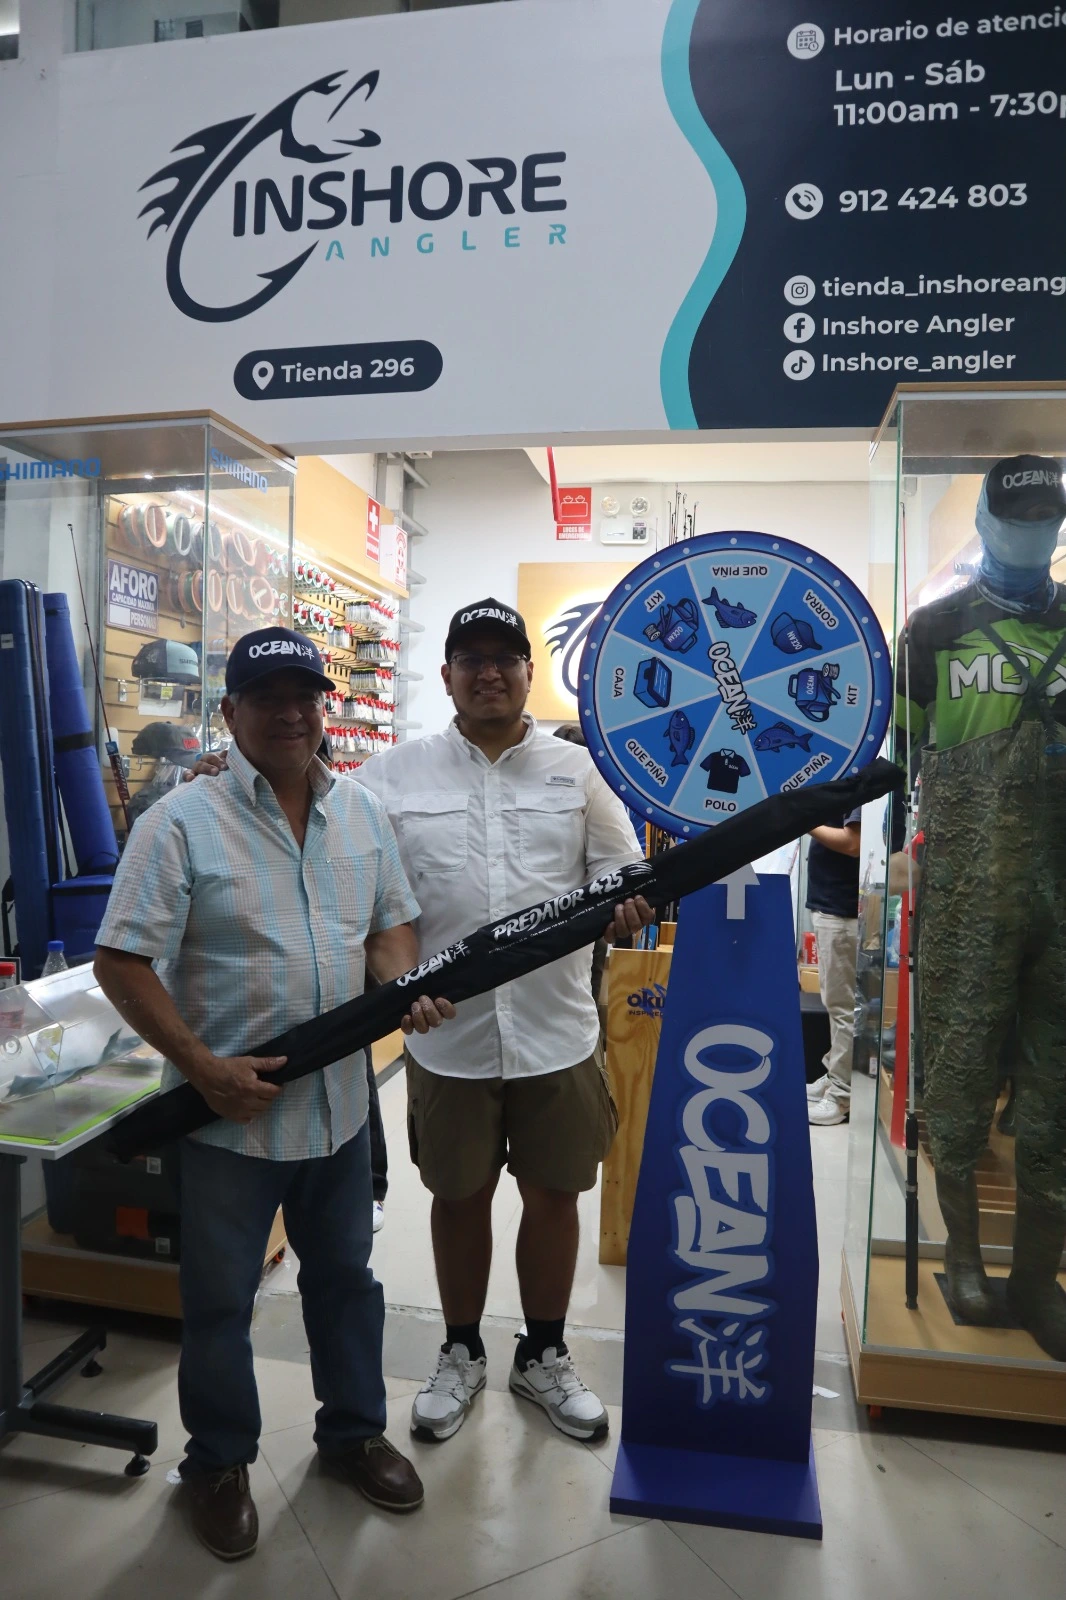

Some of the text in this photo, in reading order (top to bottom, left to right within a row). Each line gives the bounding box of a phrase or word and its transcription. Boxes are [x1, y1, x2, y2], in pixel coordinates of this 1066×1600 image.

[835, 22, 928, 45] Horario
[936, 18, 968, 37] de
[836, 70, 893, 91] Lun
[925, 60, 985, 85] Sáb
[834, 101, 957, 125] 11:00am
[232, 151, 567, 237] INSHORE
[840, 183, 1027, 212] 912 424 803
[325, 223, 567, 262] ANGLER
[822, 274, 1066, 297] tienda_inshoreang
[824, 314, 1015, 337] Inshore Angler
[281, 358, 414, 382] Tienda 296
[823, 351, 1015, 374] Inshore_angler
[211, 448, 268, 493] SHIMANO
[110, 564, 157, 601] AFORO
[711, 566, 768, 578] QUE PIÑA
[646, 592, 663, 610] KIT
[805, 592, 837, 628] GORRA
[613, 667, 625, 698] CAJA
[805, 675, 816, 695] OCEAN
[846, 685, 858, 705] KIT
[627, 740, 668, 786] QUE PIÑA
[782, 754, 830, 793] QUE PIÑA
[705, 799, 737, 812] POLO
[491, 888, 585, 941] PREDATOR
[588, 869, 624, 896] 425
